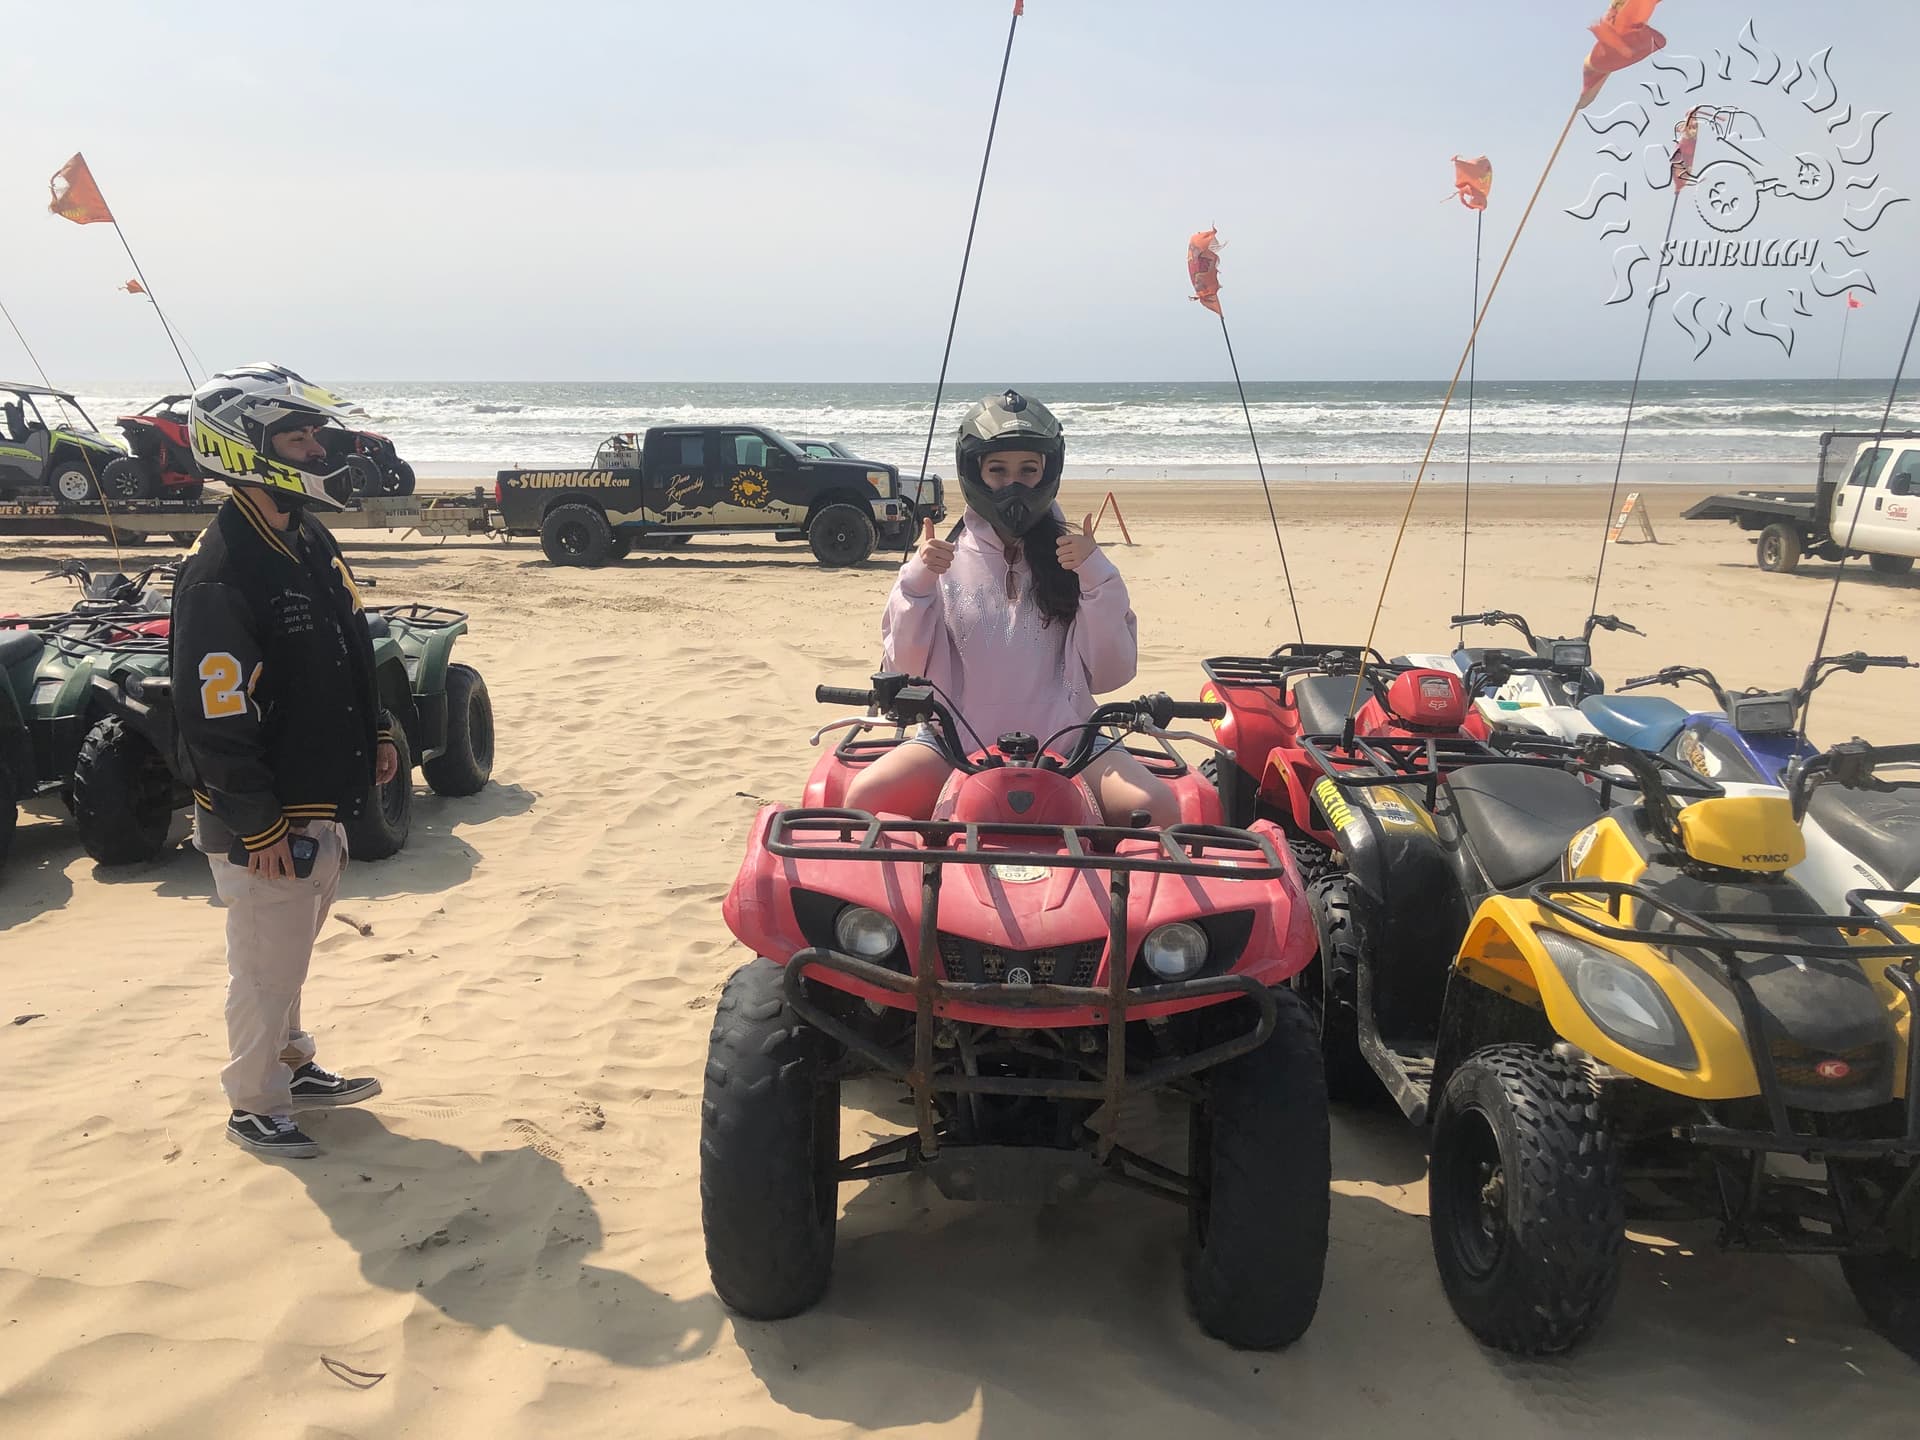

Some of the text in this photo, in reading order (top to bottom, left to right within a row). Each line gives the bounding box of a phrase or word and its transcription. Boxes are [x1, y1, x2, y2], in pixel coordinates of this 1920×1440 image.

[27, 505, 57, 515] SETS
[198, 652, 263, 722] 2
[1316, 779, 1355, 832] ARETHA
[1742, 854, 1790, 863] KYMCO
